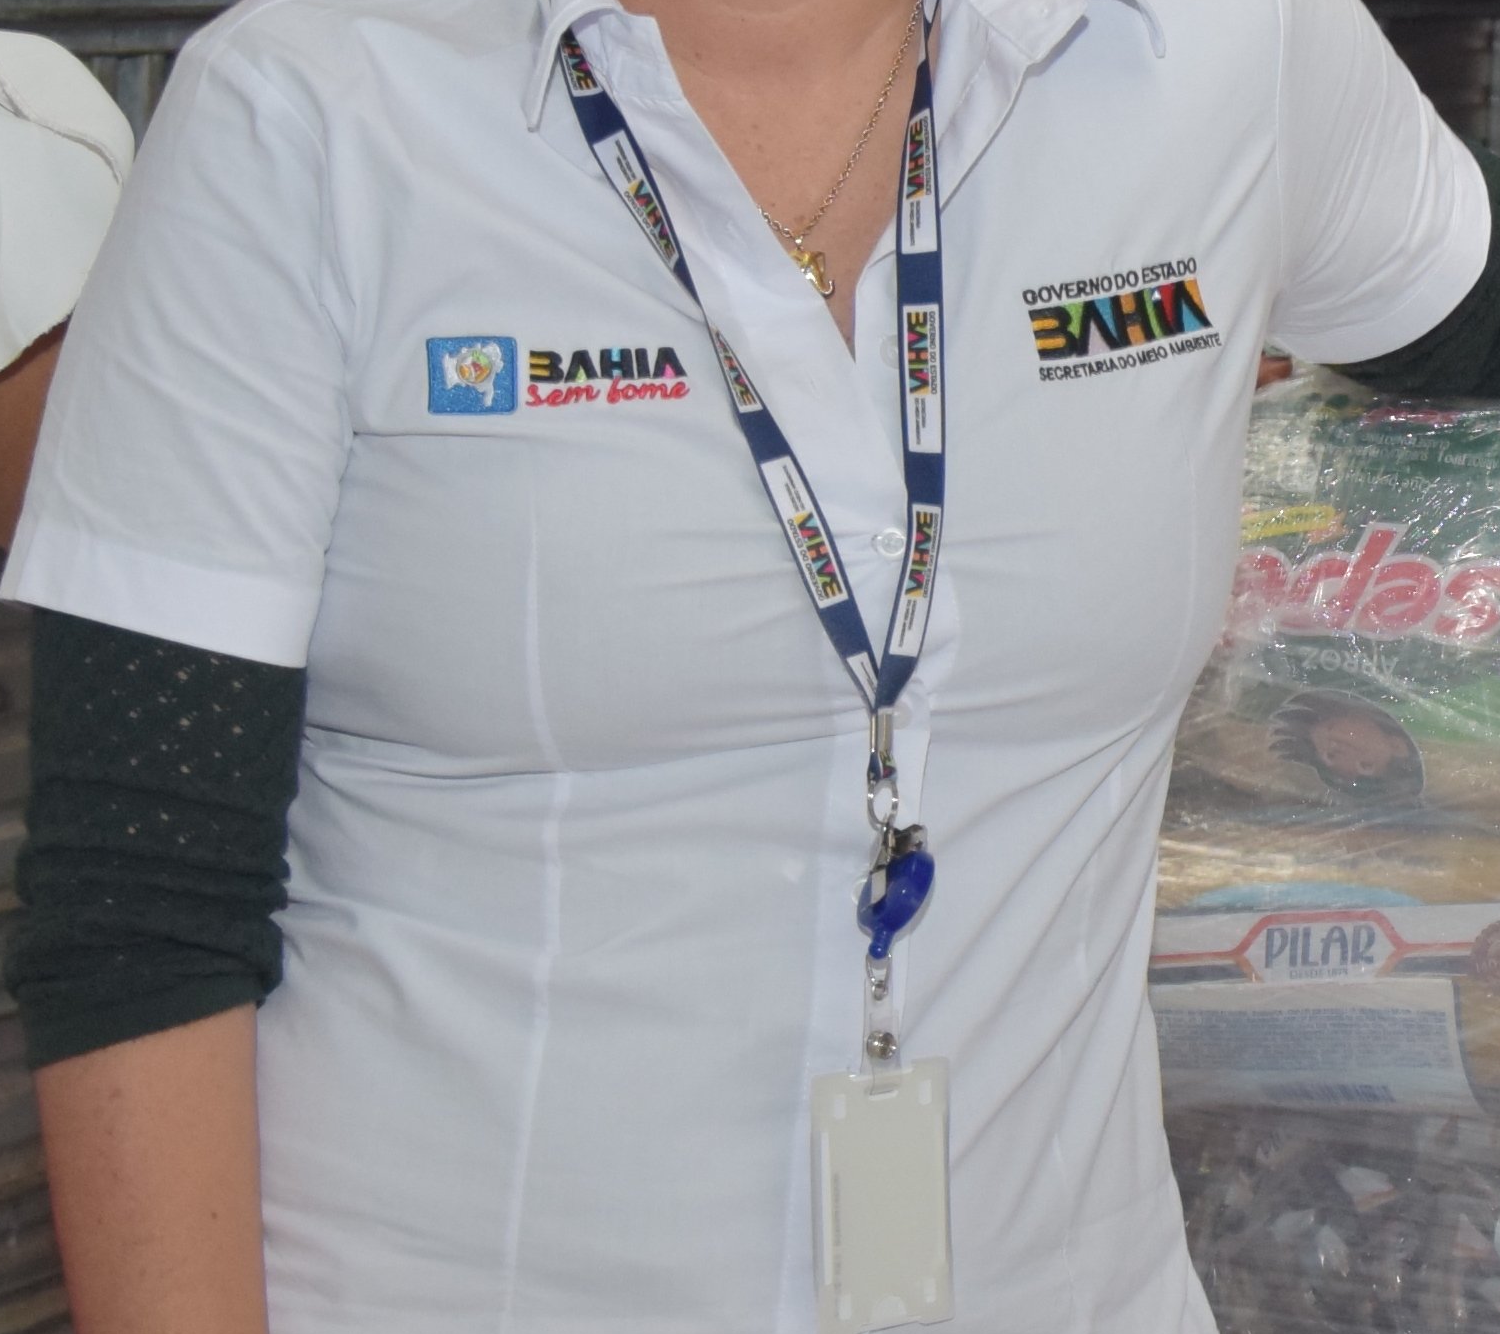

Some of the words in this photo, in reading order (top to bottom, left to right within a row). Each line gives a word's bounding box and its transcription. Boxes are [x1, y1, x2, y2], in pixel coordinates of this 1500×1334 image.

[1022, 275, 1113, 305] GOVERNO
[1114, 271, 1140, 291] DO
[1141, 257, 1197, 285] ESTADO
[1028, 277, 1214, 361] BAHIA
[529, 347, 688, 384] BAHIA
[906, 311, 931, 395] BAHIA
[1039, 358, 1118, 381] SECRETARIA
[1118, 353, 1137, 369] DO
[1138, 345, 1168, 365] MEIO
[1169, 332, 1222, 356] AMBIENTE
[793, 511, 843, 599] BAHIA
[905, 511, 933, 598] BAHIA
[1265, 924, 1376, 969] PILAR
